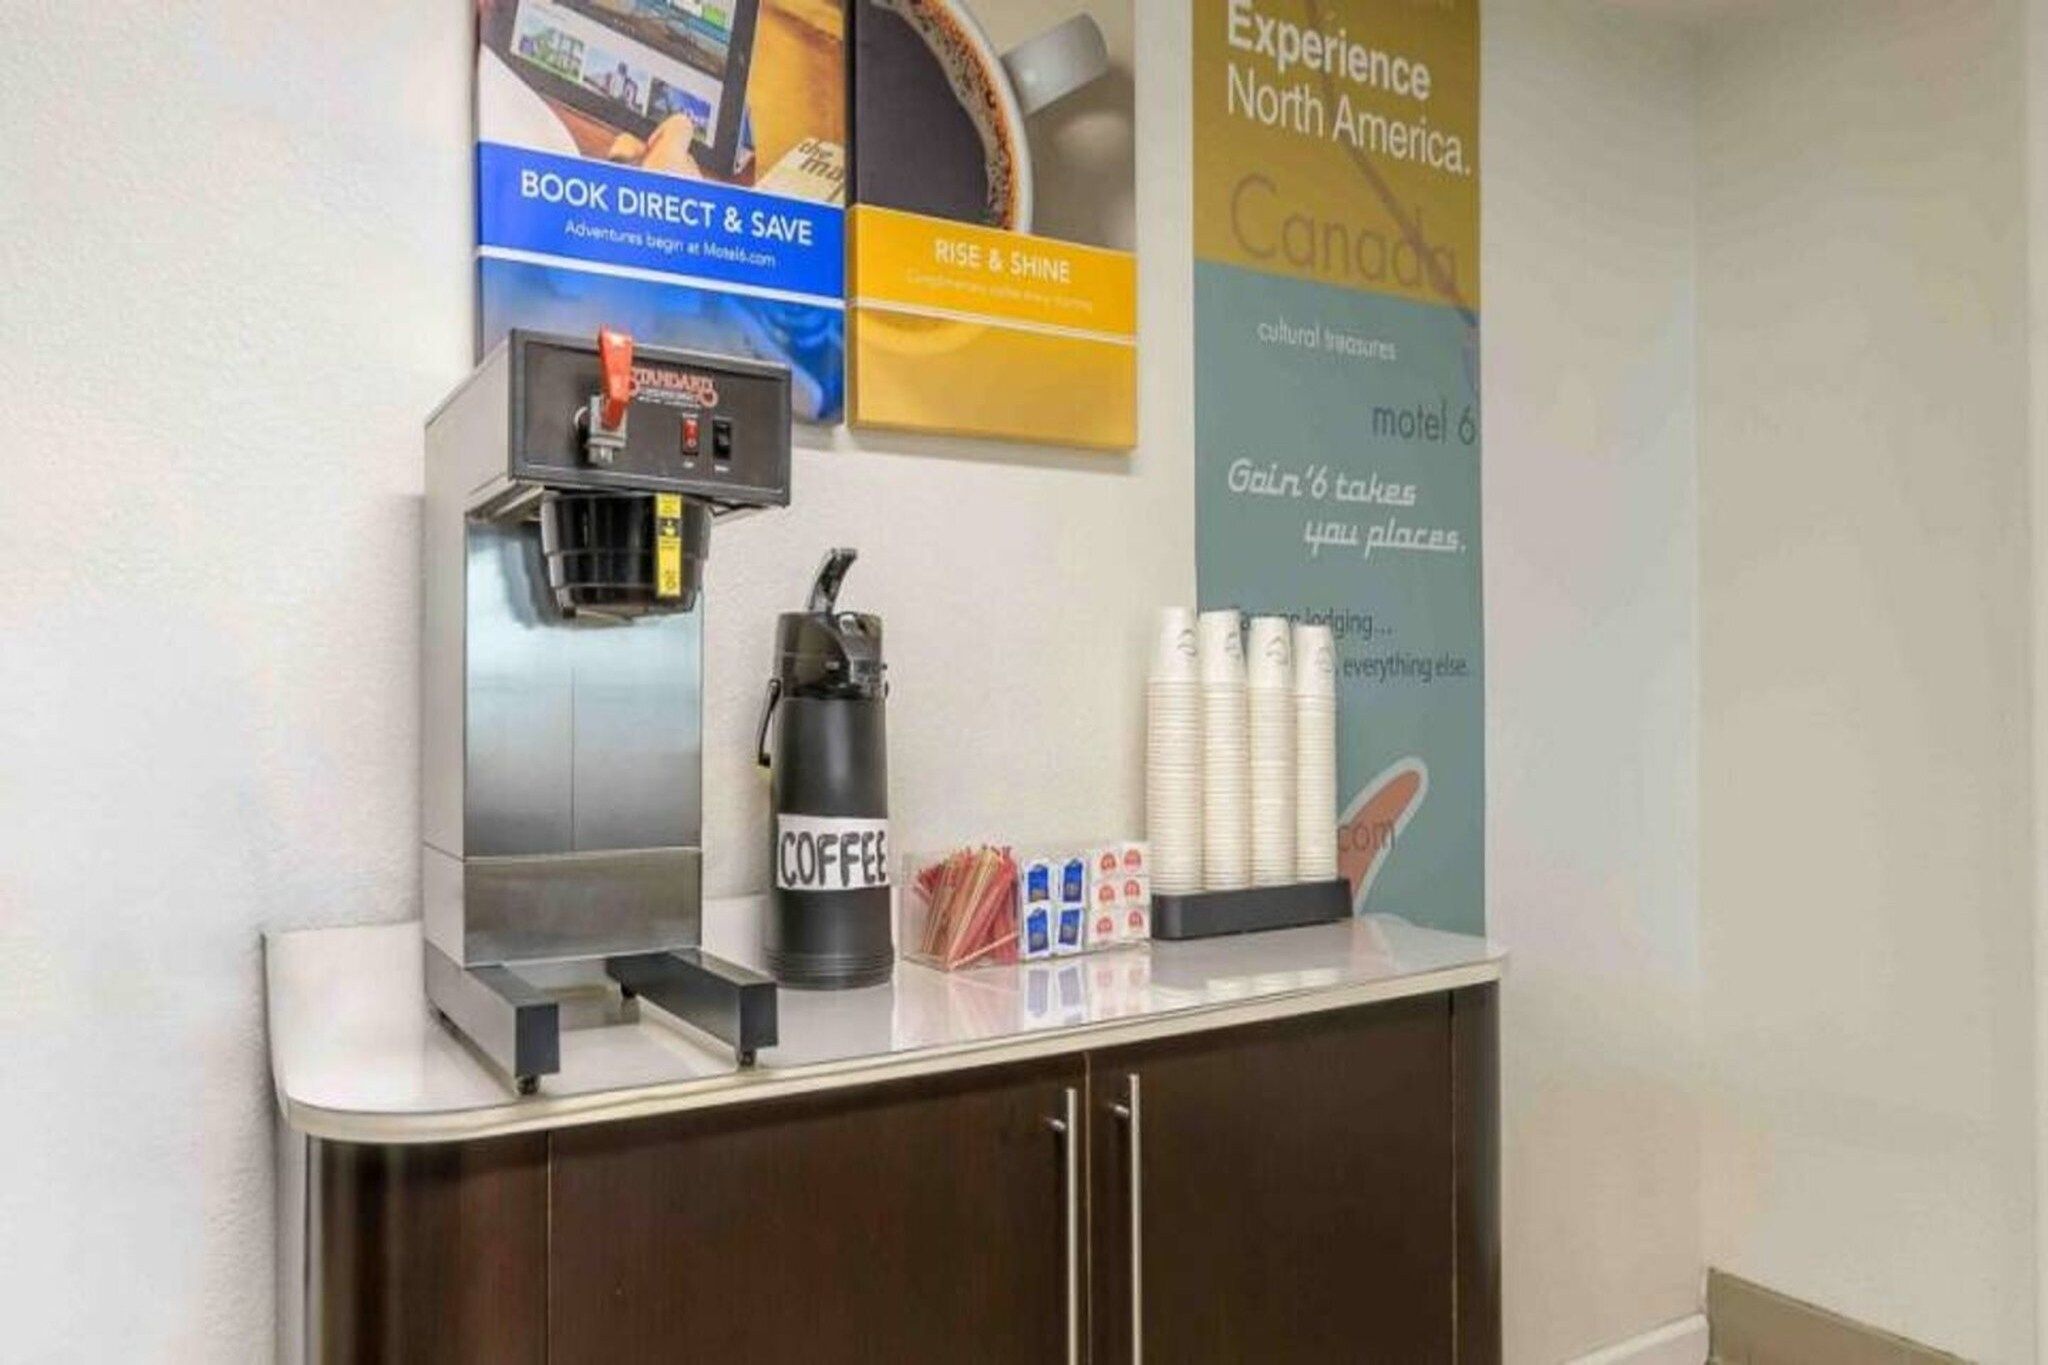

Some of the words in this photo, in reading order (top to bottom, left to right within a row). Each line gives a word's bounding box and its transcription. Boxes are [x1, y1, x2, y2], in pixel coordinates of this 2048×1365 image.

[1228, 0, 1431, 100] Experience
[1228, 62, 1324, 138] North
[1332, 94, 1471, 175] America.
[521, 170, 609, 212] BOOK
[618, 187, 715, 229] DIRECT
[723, 207, 742, 234] &
[751, 211, 814, 246] SAVE
[565, 219, 643, 247] Adventures
[645, 233, 684, 257] begin
[687, 242, 701, 257] at
[1231, 172, 1457, 297] Canada
[934, 238, 982, 267] RISE
[988, 248, 1002, 272] &
[1010, 252, 1071, 284] SHINE
[1257, 317, 1320, 348] cultural
[1324, 326, 1396, 360] treasures
[1372, 400, 1446, 443] motel
[1458, 404, 1476, 445] 6
[1336, 472, 1416, 507] takes
[1305, 521, 1358, 557] you
[1364, 517, 1467, 560] places.
[1343, 650, 1431, 684] everything
[780, 831, 886, 886] COFFEE
